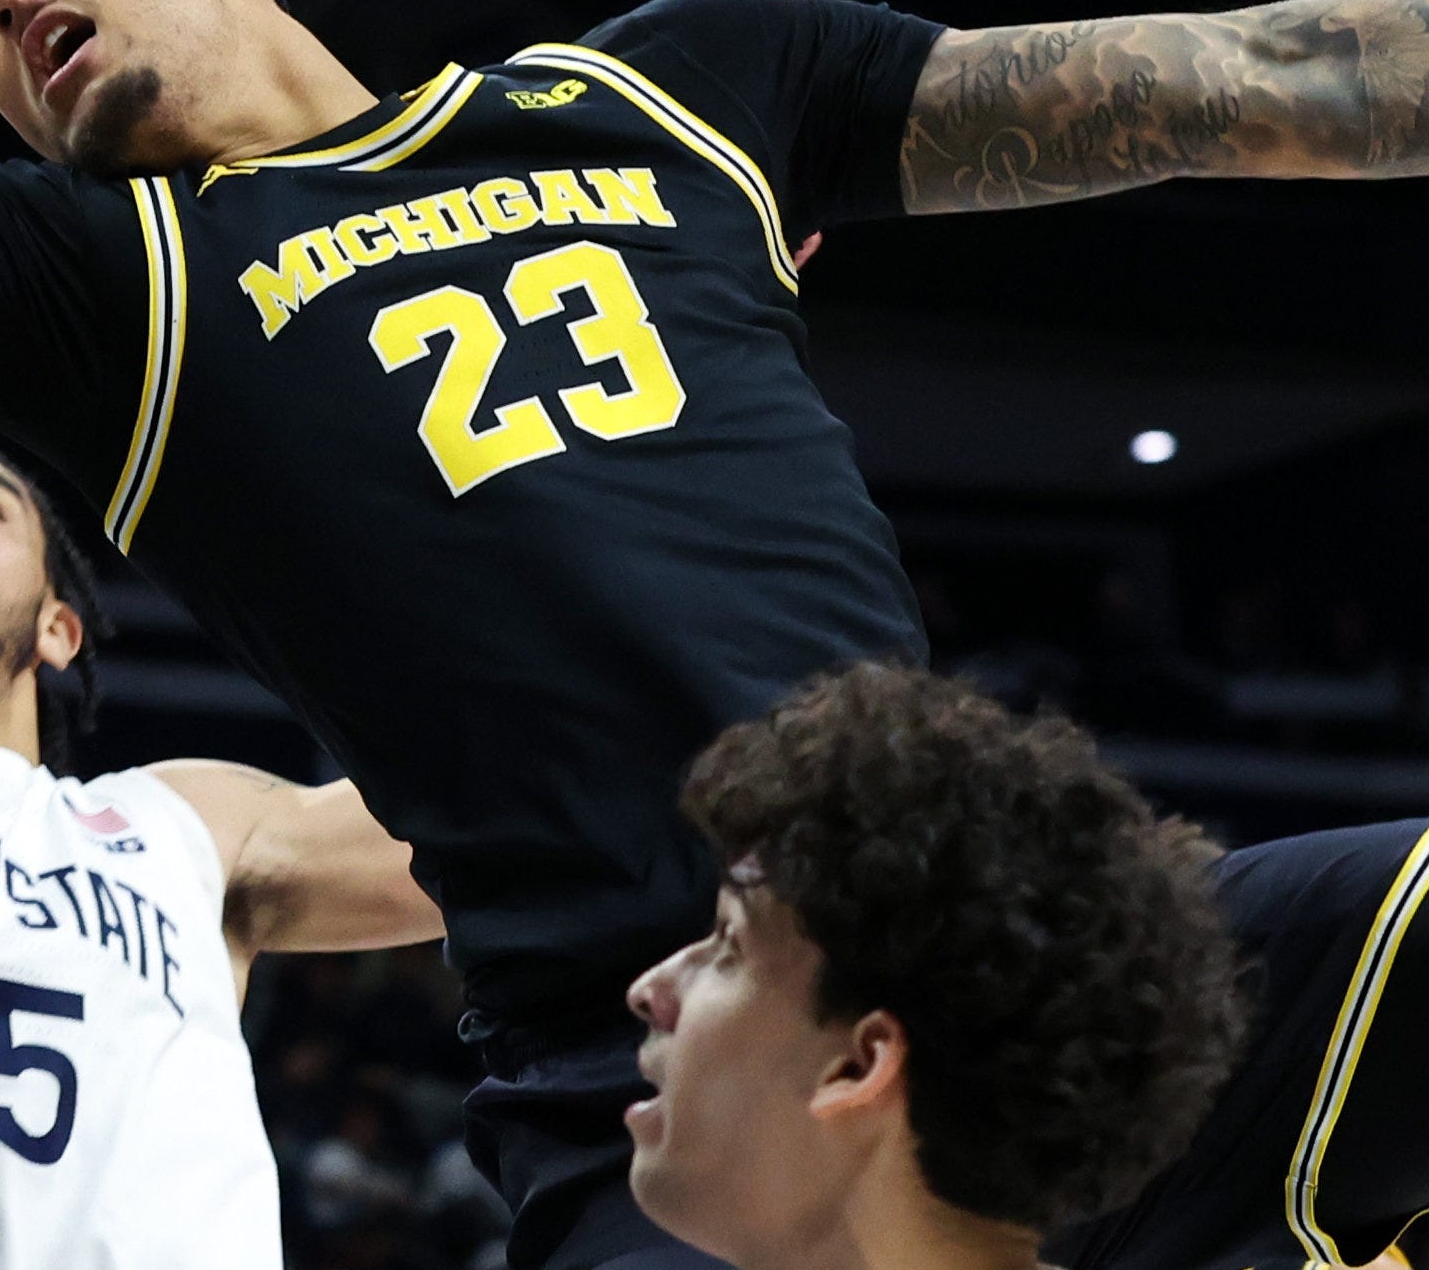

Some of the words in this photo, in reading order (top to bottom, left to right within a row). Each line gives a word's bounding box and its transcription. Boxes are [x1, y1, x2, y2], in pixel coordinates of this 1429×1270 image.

[239, 167, 677, 342] MICHIGAN
[368, 241, 687, 498] 23
[3, 857, 185, 1019] STATE
